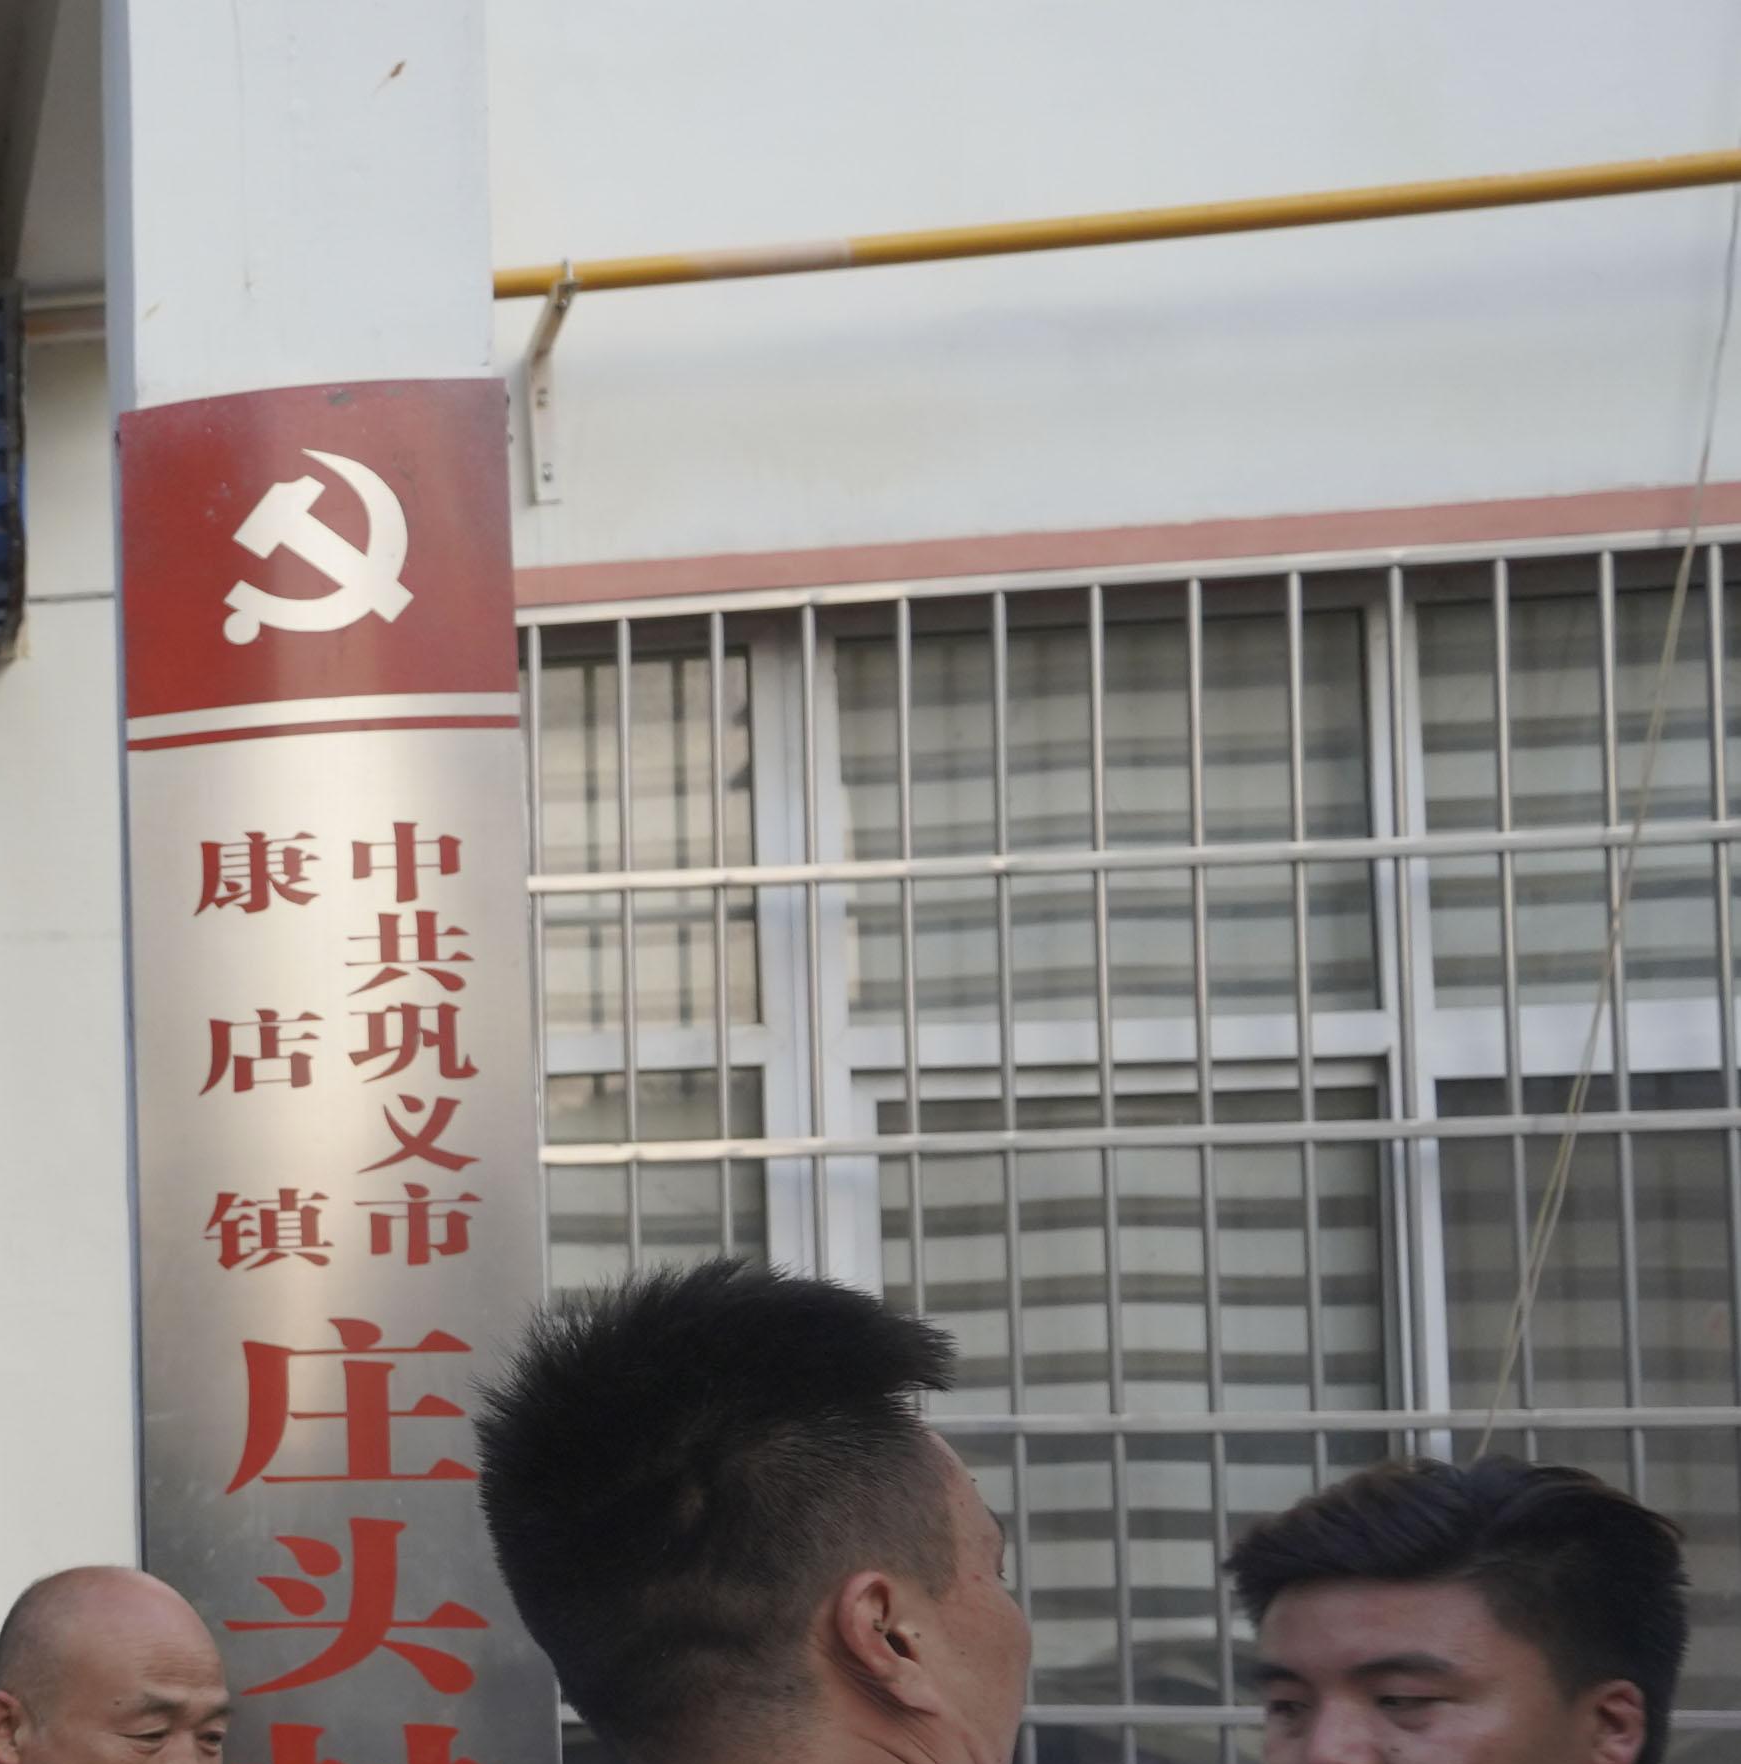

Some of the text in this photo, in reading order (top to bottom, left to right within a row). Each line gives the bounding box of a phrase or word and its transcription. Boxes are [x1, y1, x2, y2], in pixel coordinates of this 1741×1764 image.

[193, 831, 335, 1271] 康店镇
[344, 822, 484, 1267] 中共巩义市
